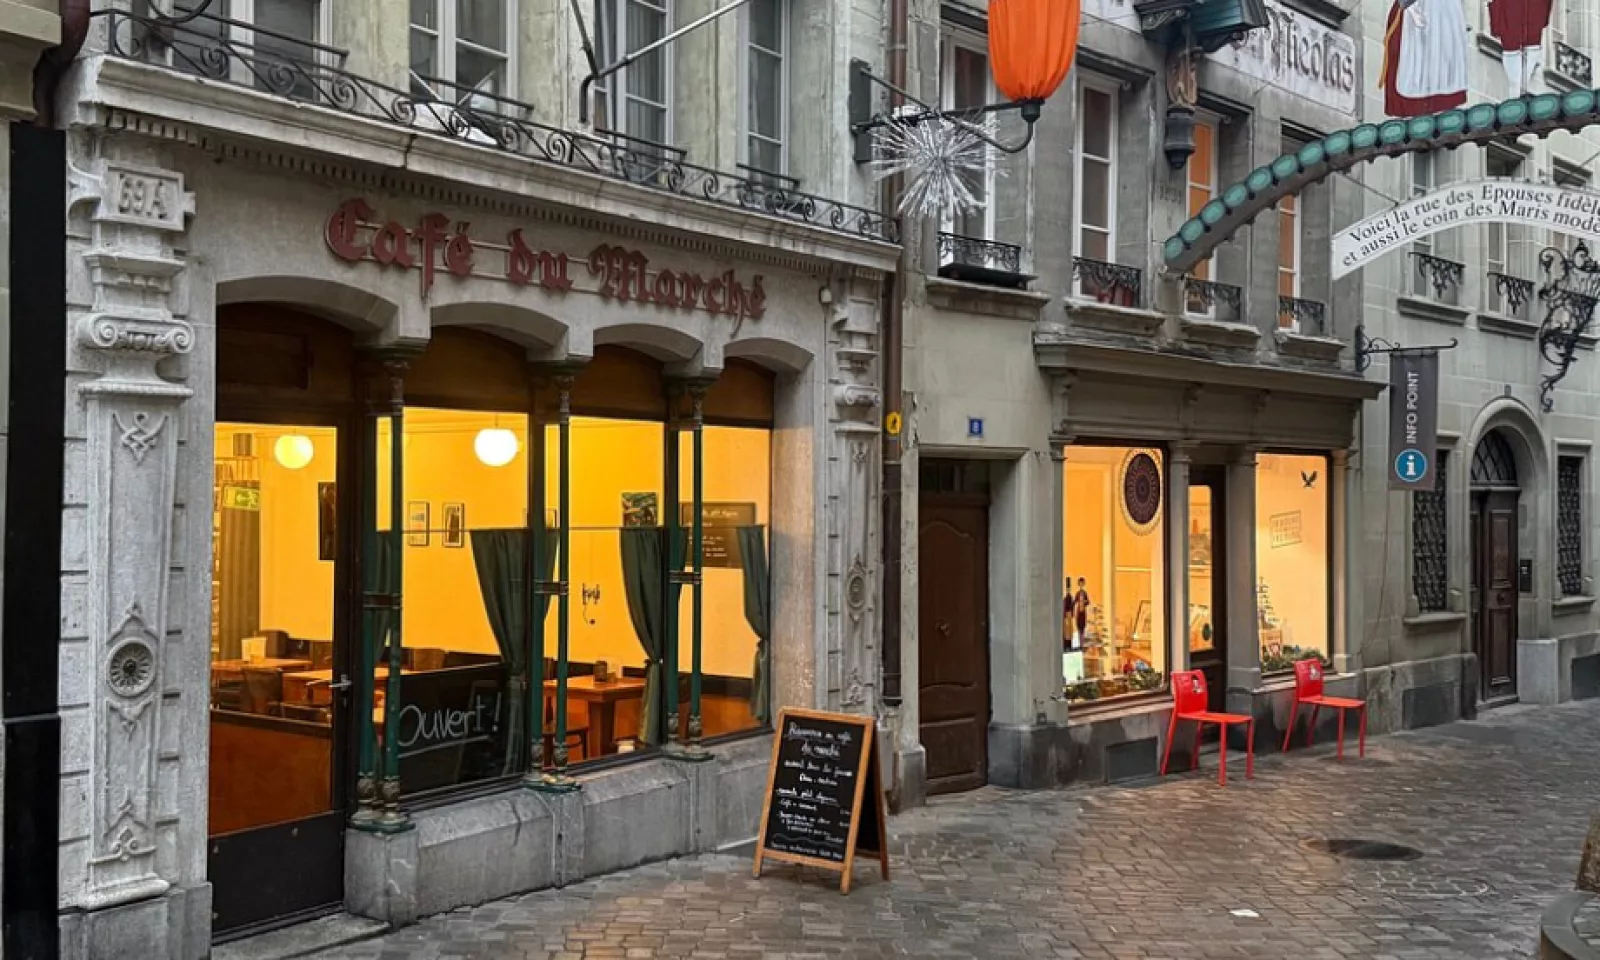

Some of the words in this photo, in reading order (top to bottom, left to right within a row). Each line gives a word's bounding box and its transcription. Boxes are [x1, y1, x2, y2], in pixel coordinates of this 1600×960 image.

[1343, 252, 1356, 267] et
[1361, 230, 1400, 257] aussi
[1404, 220, 1418, 237] le
[1423, 206, 1459, 228] coin
[1465, 200, 1493, 217] des
[1498, 201, 1549, 221] Maris
[1350, 214, 1391, 243] Voici
[1393, 210, 1410, 225] la
[1414, 199, 1441, 216] rue
[1446, 188, 1474, 206] des
[1482, 184, 1552, 207] Epouses
[1556, 192, 1600, 217] fidèl
[324, 198, 475, 299] Café
[506, 228, 573, 293] du
[587, 243, 768, 339] Marché
[1406, 372, 1419, 410] POINT
[1407, 412, 1417, 444] INFO
